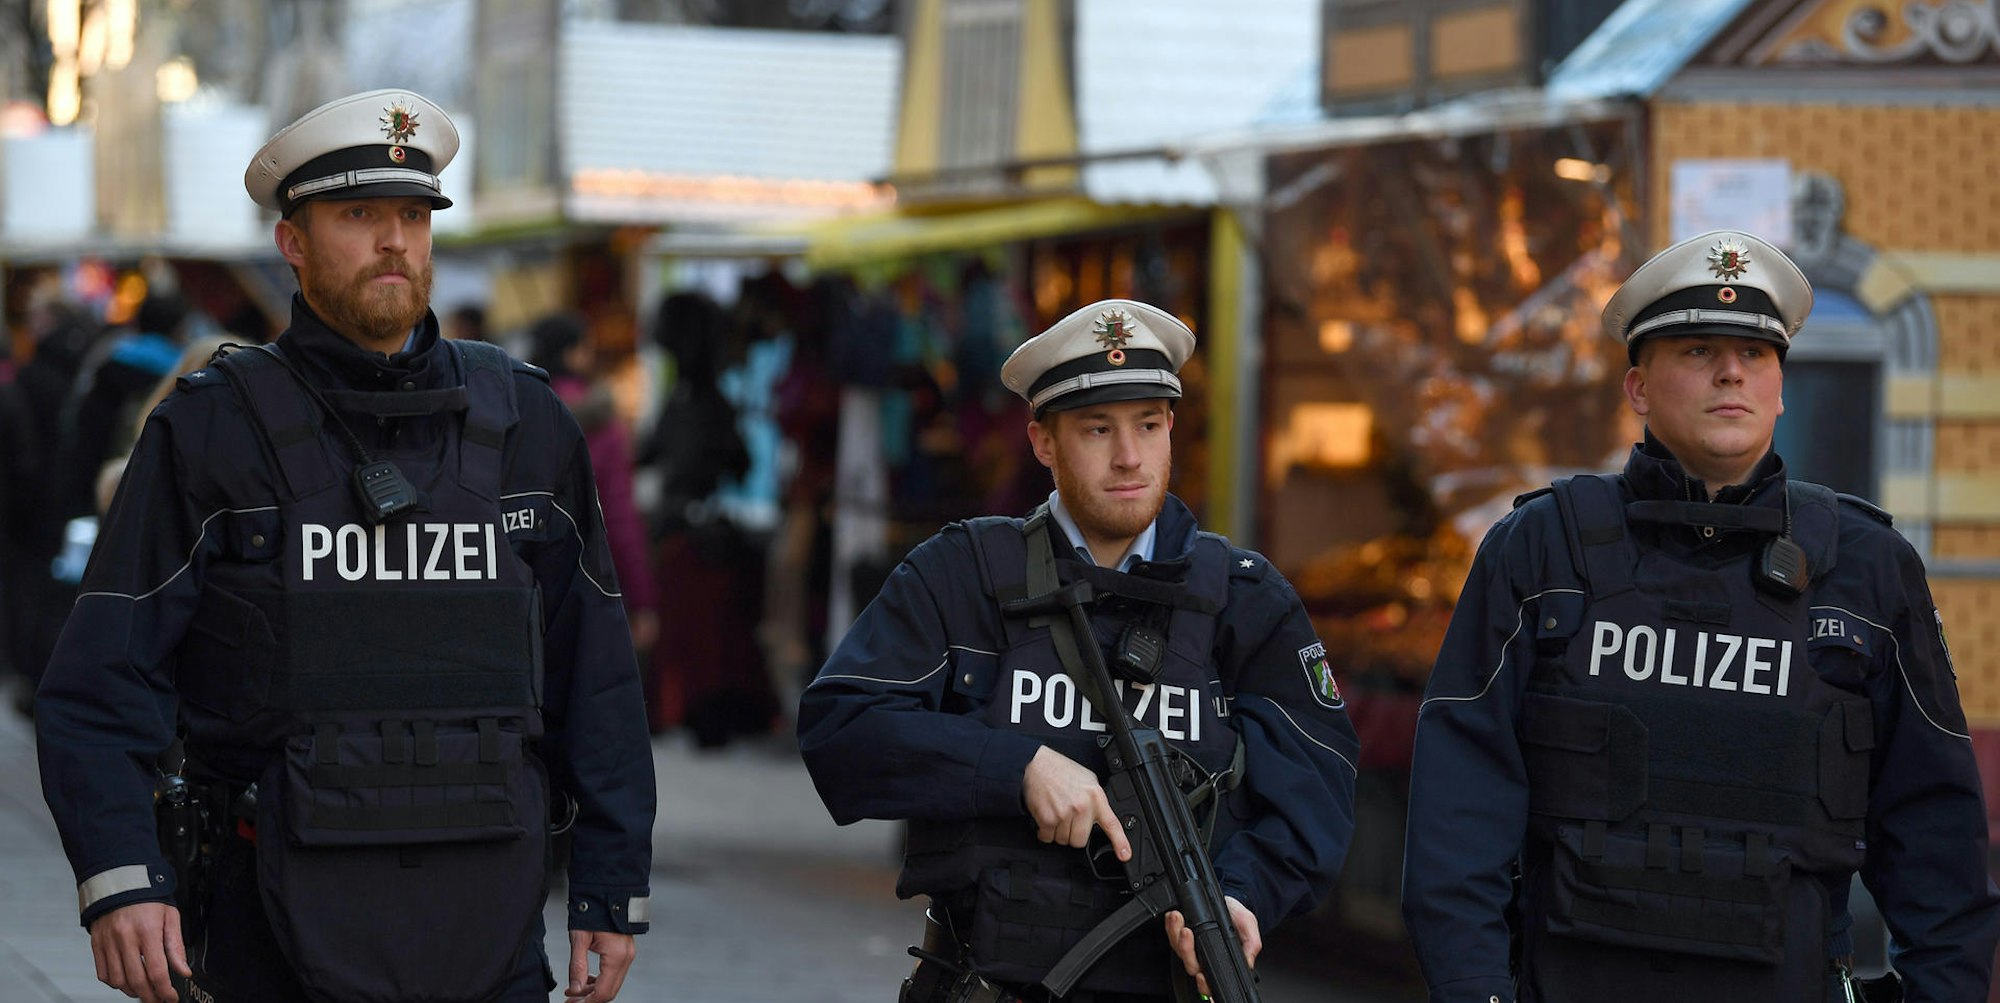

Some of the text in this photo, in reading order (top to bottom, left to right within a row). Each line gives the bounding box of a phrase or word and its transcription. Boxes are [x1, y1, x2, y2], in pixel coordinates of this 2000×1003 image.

[302, 523, 497, 580] POLIZEI
[1589, 620, 1793, 697] POLIZEI
[1807, 618, 1845, 641] IZEI
[1010, 669, 1200, 742] POLZEI
